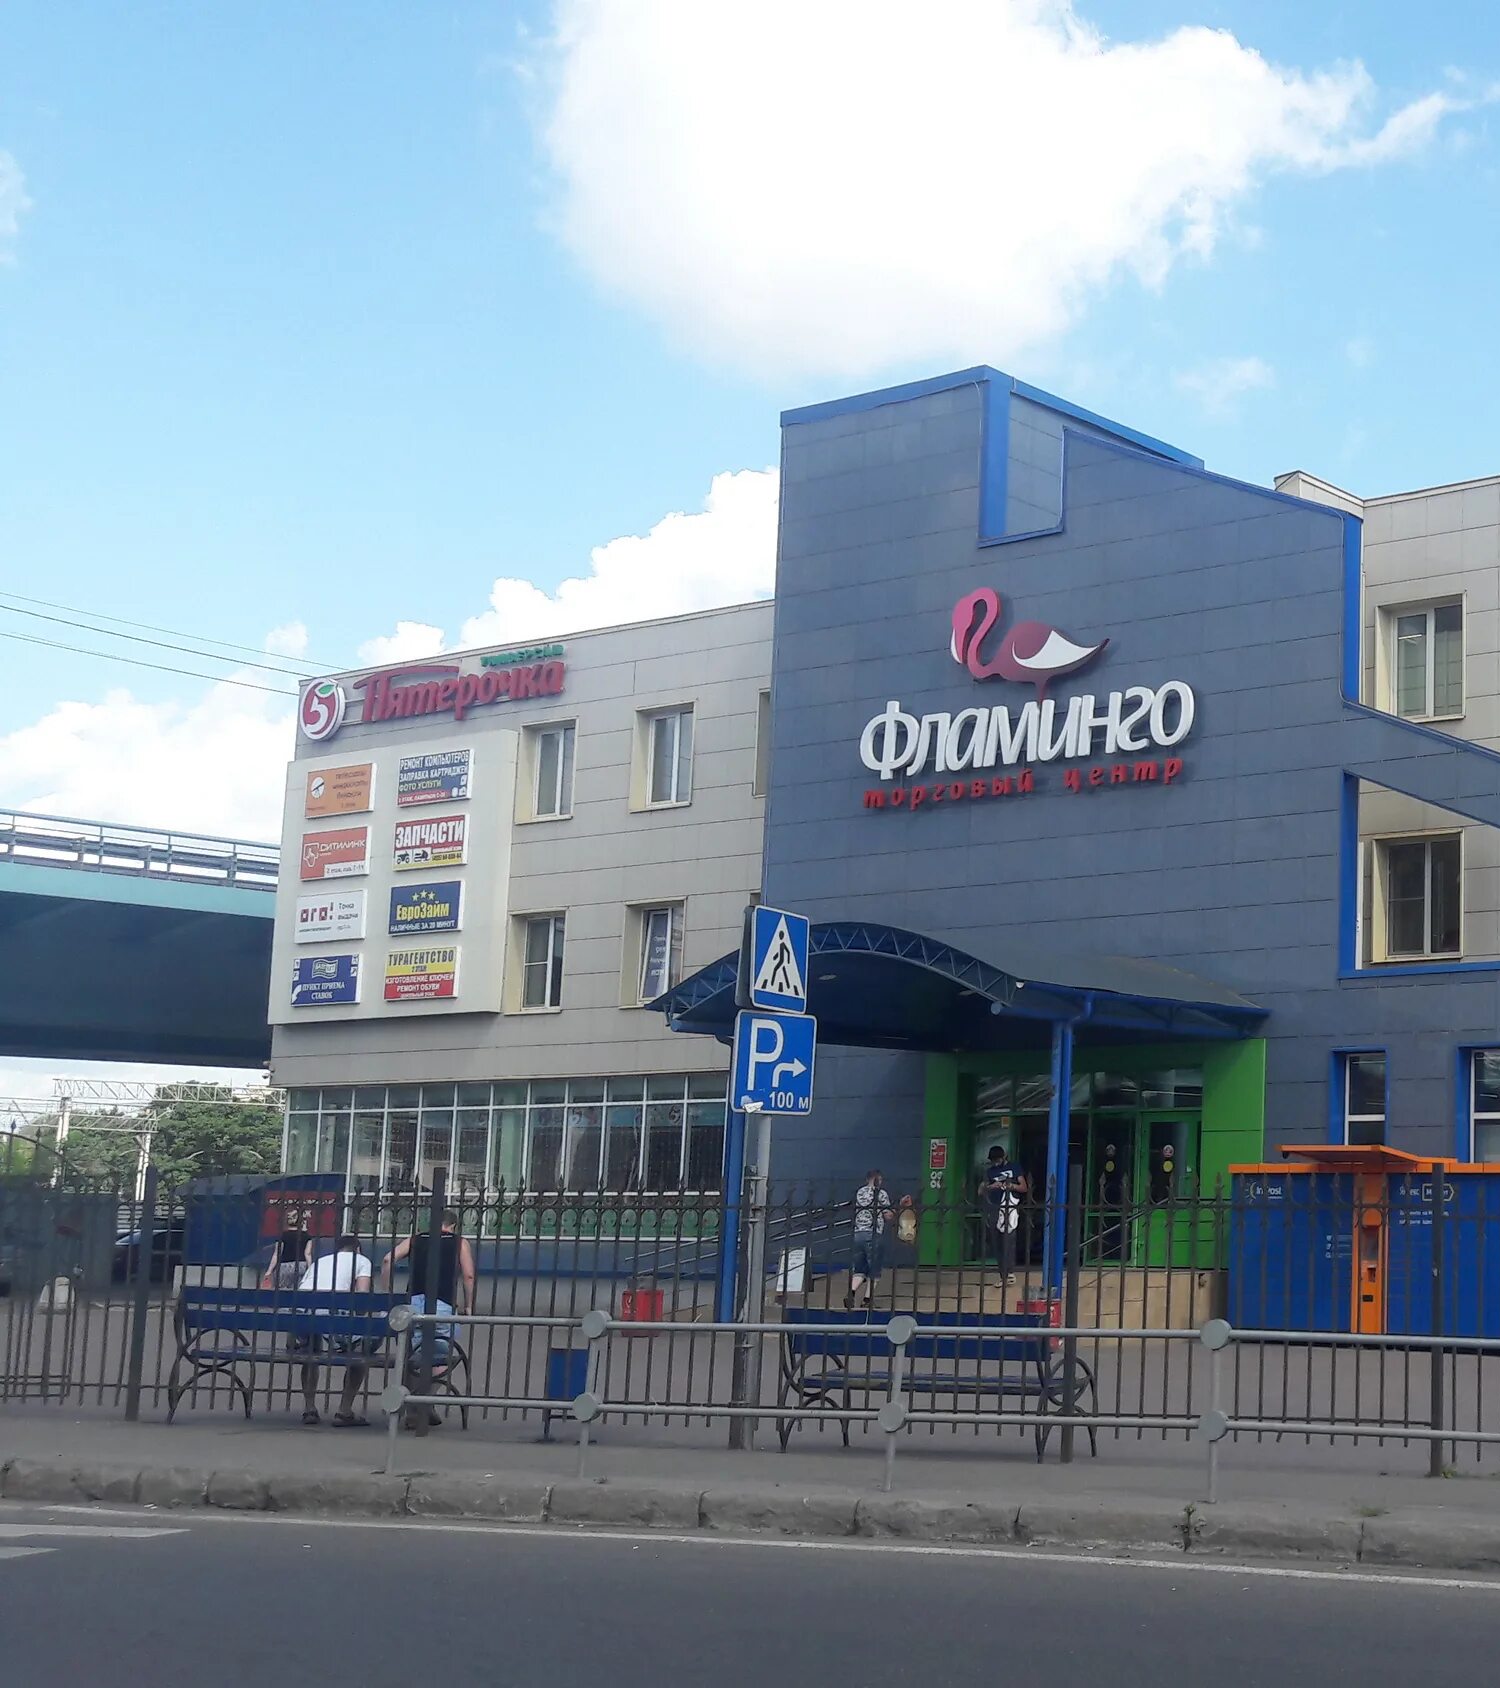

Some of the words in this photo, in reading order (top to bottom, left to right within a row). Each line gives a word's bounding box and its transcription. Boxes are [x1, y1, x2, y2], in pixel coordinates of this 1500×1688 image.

[353, 661, 566, 721] Пятерочка
[400, 757, 424, 771] РЕМОНТ
[863, 768, 1034, 811] торговый
[1063, 757, 1184, 793] центр
[395, 820, 465, 848] ЗАПЧАСТИ
[320, 840, 365, 852] СИТИЛИНК
[396, 901, 450, 921] ЕвроЗайм
[388, 950, 454, 966] ТУРАГЕНТСТВО
[769, 1091, 794, 1109] 100
